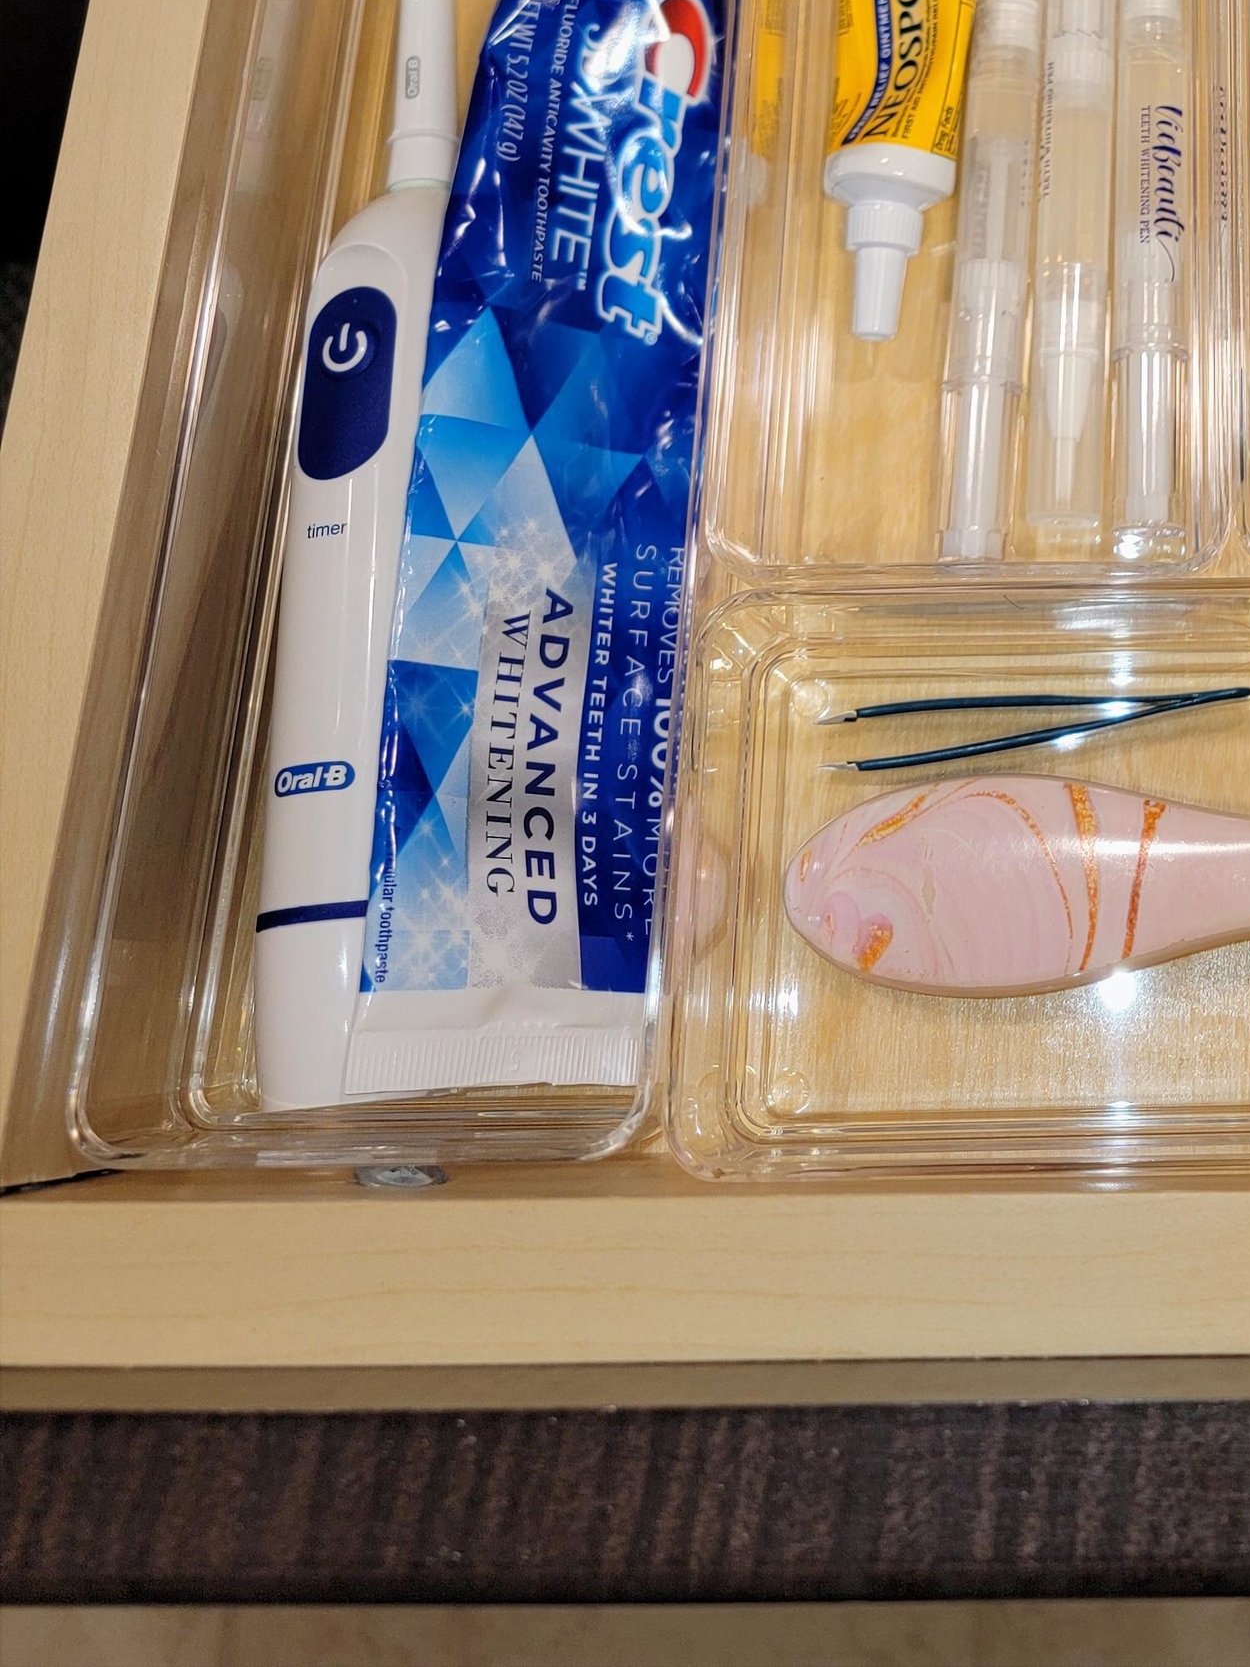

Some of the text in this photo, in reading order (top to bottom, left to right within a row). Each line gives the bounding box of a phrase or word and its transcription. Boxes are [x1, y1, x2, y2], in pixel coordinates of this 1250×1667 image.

[540, 77, 563, 173] ANTICAVITY
[901, 113, 917, 140] FIRST
[1139, 105, 1151, 246] TEETH WHITENING PEN
[530, 176, 552, 283] TOOTHPASTE
[307, 523, 348, 540] timer
[619, 543, 659, 739] SURFACE
[656, 545, 686, 683] REMOVES
[277, 764, 348, 795] Oral-B
[484, 609, 532, 898] WHITENING
[522, 586, 575, 925] ADVANCED
[580, 561, 619, 907] WHITER TEETH IN 3 DAYS
[374, 905, 396, 984] toothpaste
